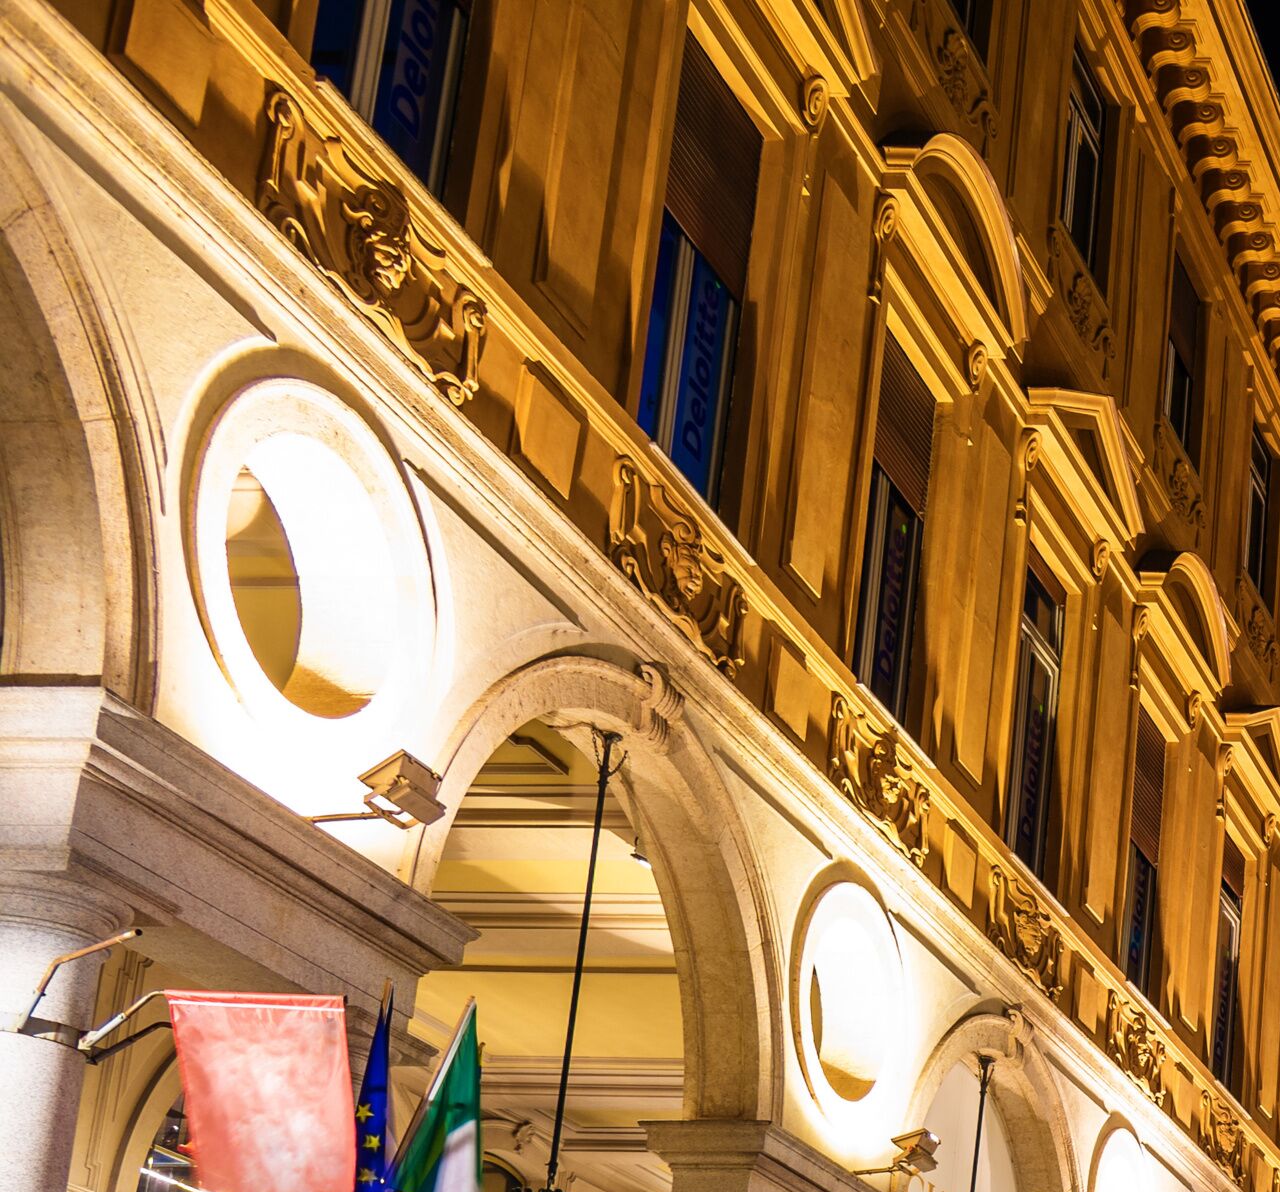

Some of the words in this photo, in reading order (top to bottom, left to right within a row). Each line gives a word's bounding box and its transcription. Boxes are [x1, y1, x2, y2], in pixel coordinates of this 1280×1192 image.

[682, 279, 721, 463] Deloitte
[877, 530, 908, 682] Deloitte
[1021, 708, 1042, 839] Deloitte
